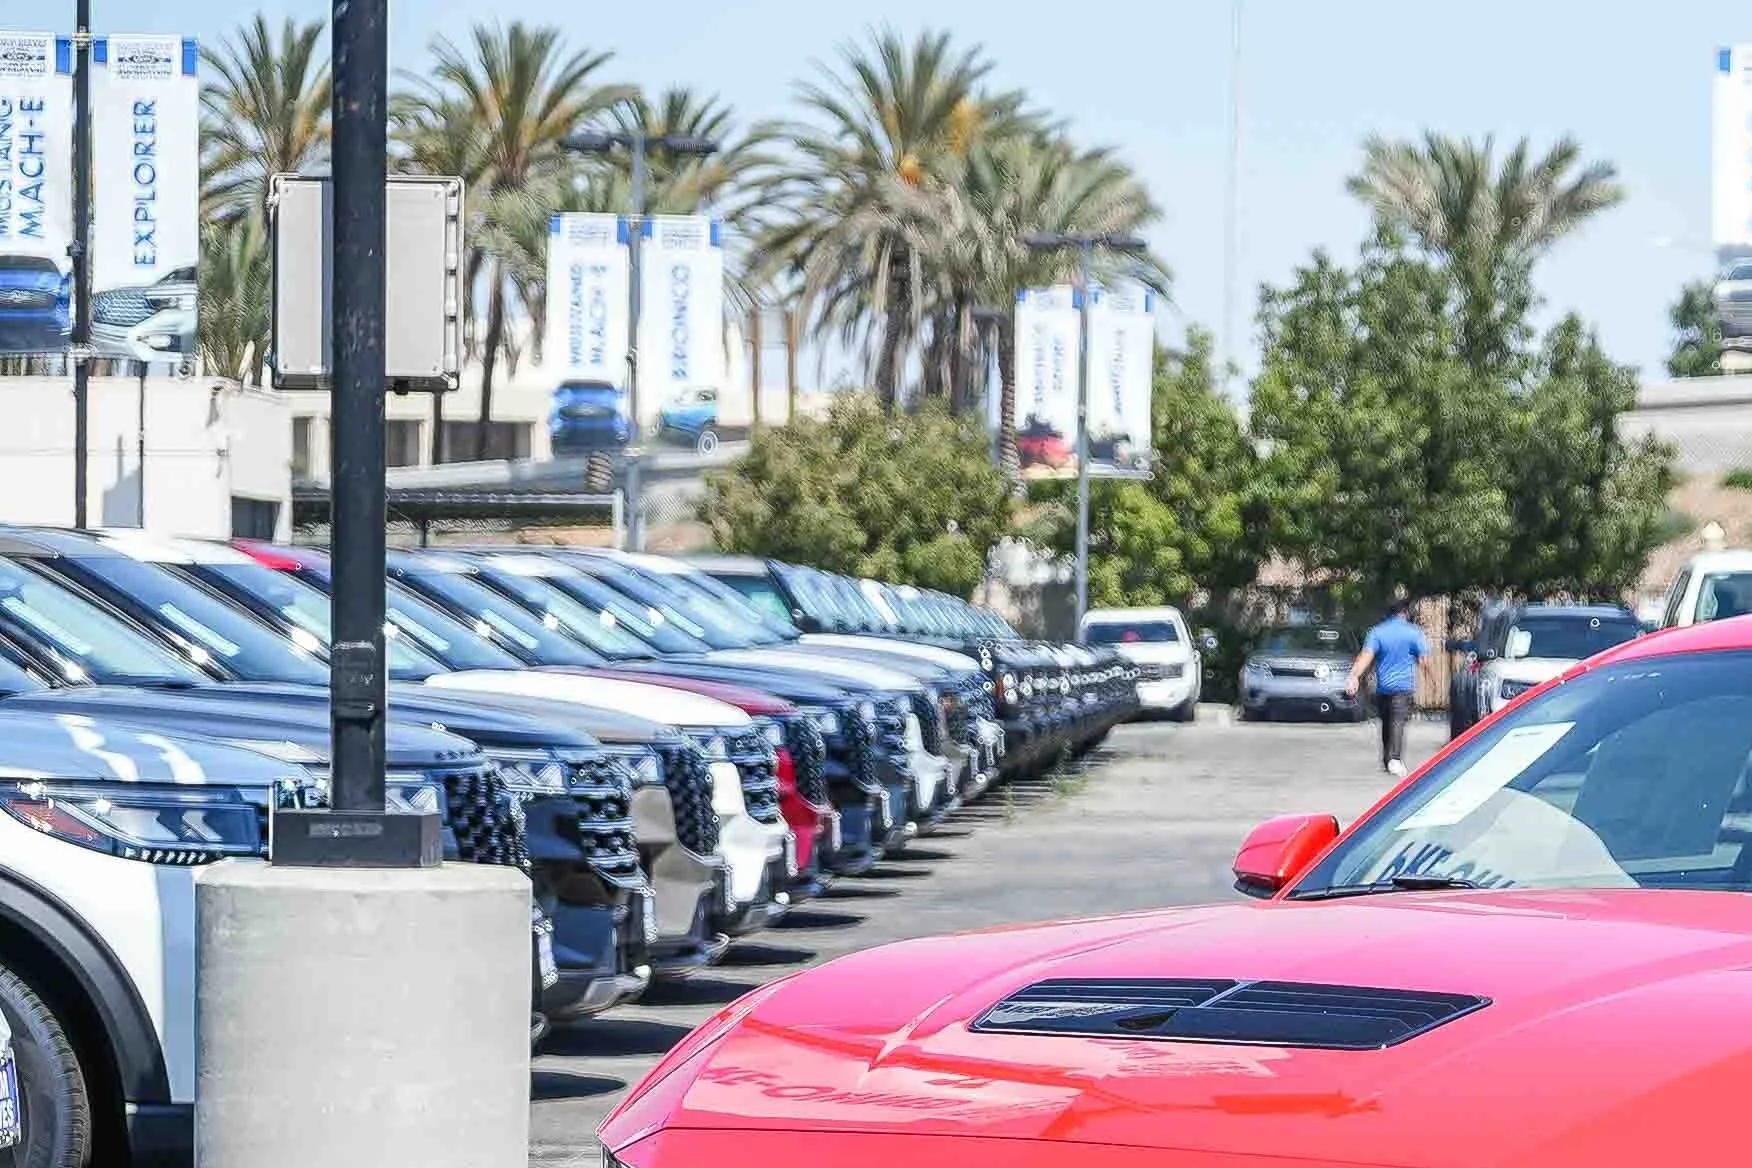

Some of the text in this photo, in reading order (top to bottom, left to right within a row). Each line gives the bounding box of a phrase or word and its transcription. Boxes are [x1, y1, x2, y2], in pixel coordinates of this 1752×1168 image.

[19, 96, 45, 238] MACH-E
[134, 99, 156, 266] EXPLORER
[672, 264, 690, 379] BRONCO
